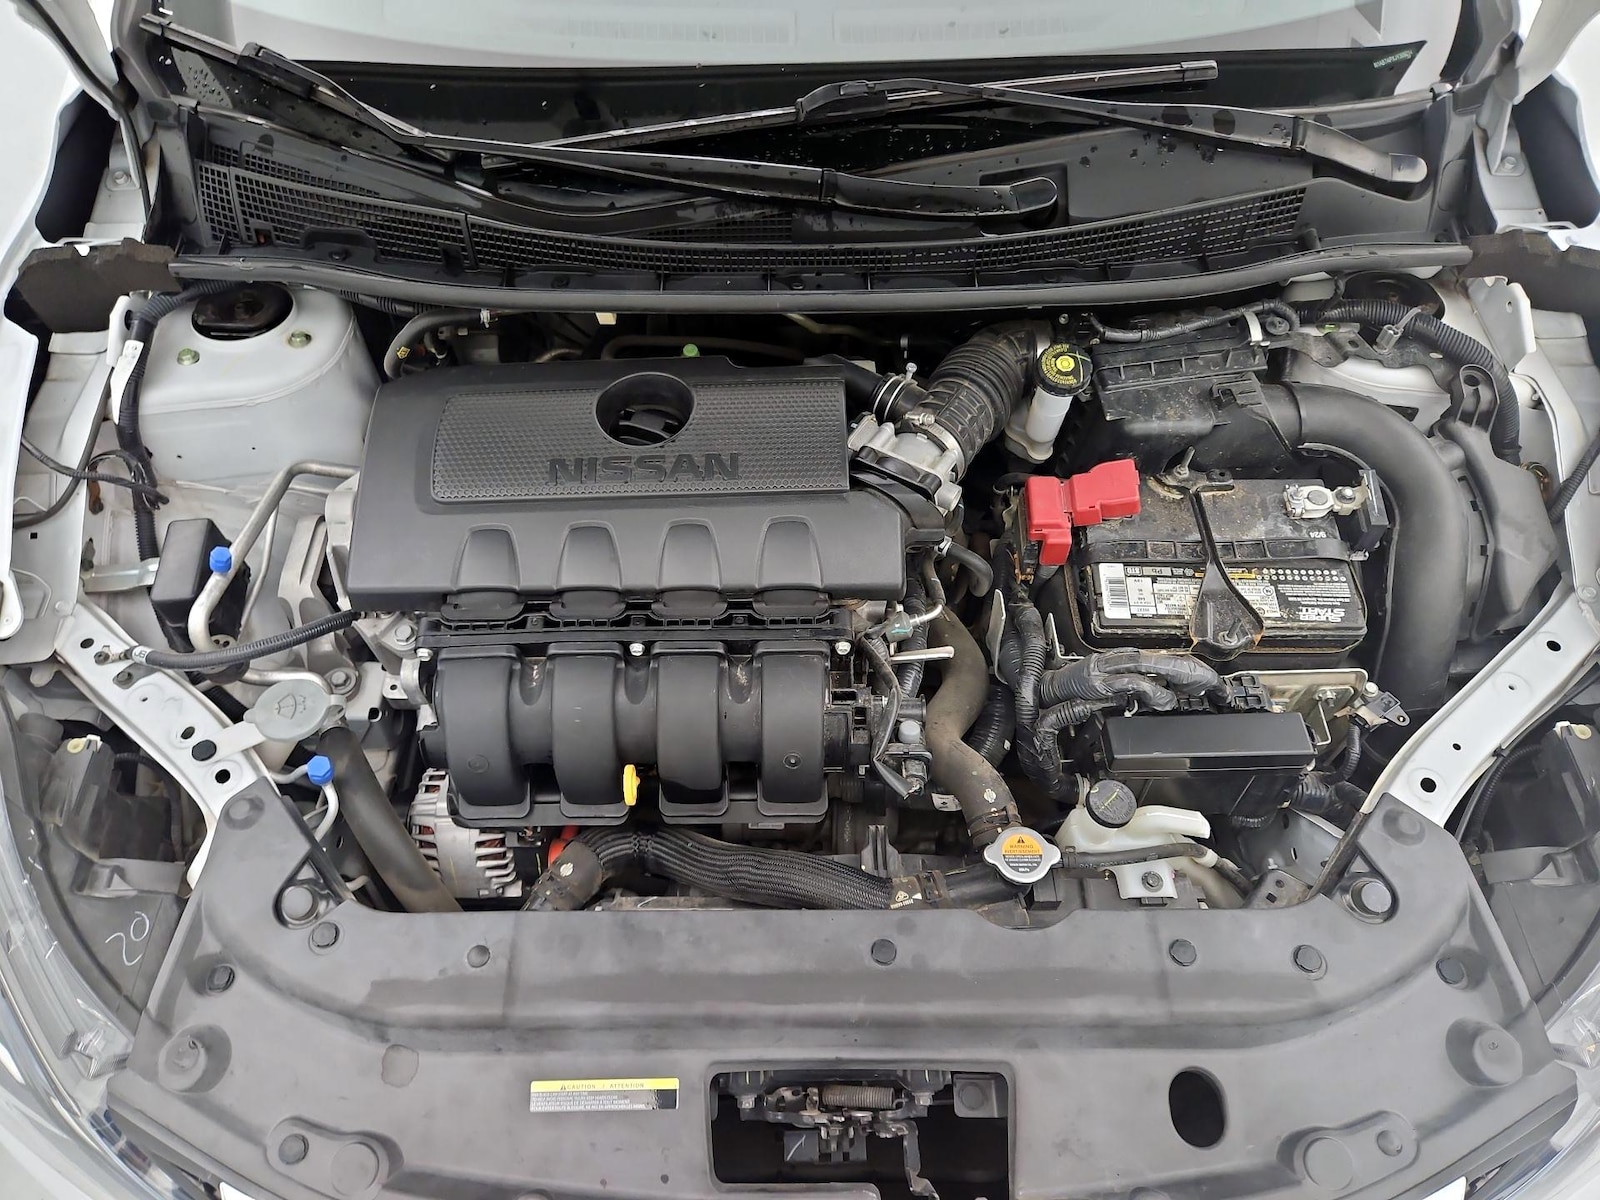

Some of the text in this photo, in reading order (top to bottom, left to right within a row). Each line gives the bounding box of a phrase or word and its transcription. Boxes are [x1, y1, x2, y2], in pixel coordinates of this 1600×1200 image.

[546, 452, 740, 485] NISSAN
[1298, 607, 1345, 617] START
[1300, 614, 1341, 623] SUPER
[105, 911, 149, 966] 20
